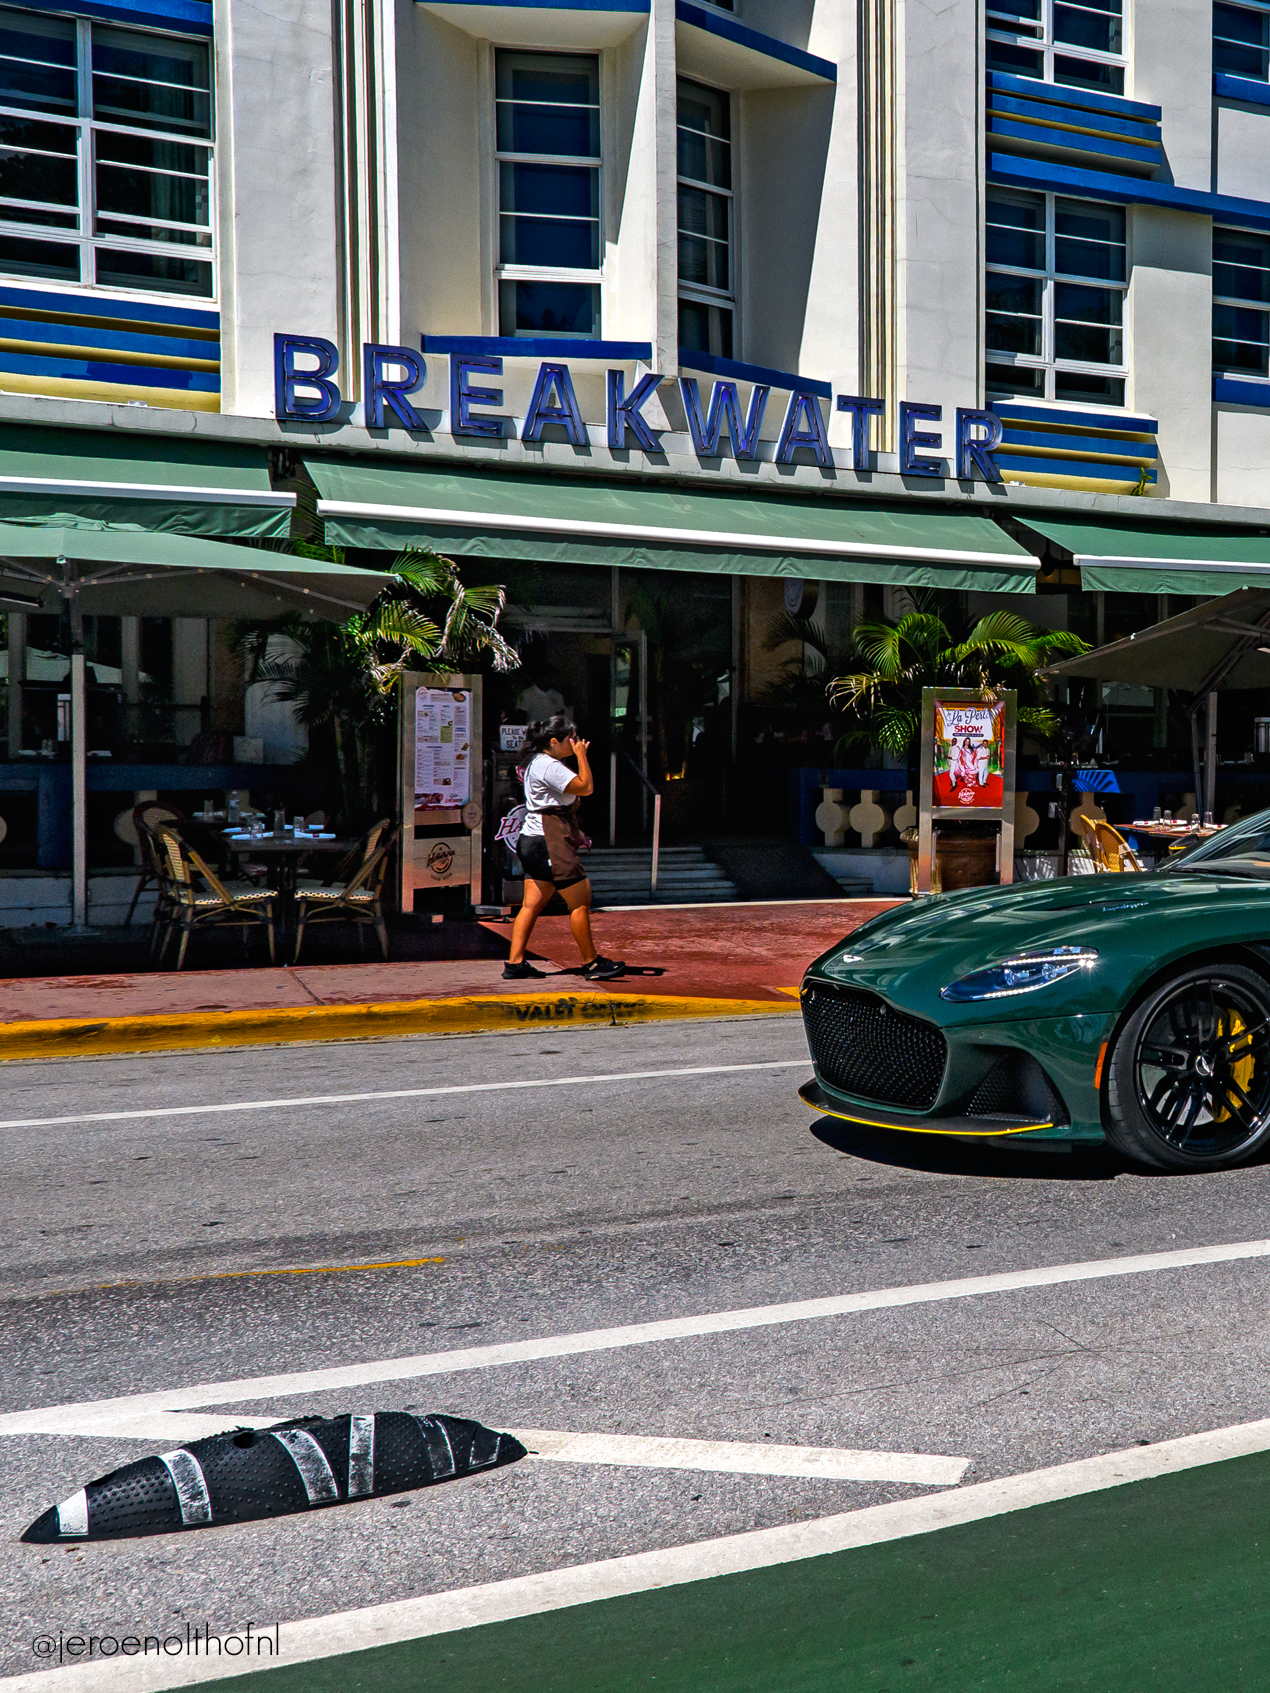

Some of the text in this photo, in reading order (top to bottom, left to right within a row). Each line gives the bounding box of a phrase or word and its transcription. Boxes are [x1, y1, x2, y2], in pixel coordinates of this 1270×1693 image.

[273, 333, 1002, 483] BREAKWATER
[501, 728, 520, 736] PLEASE
[506, 740, 522, 749] SEAT
